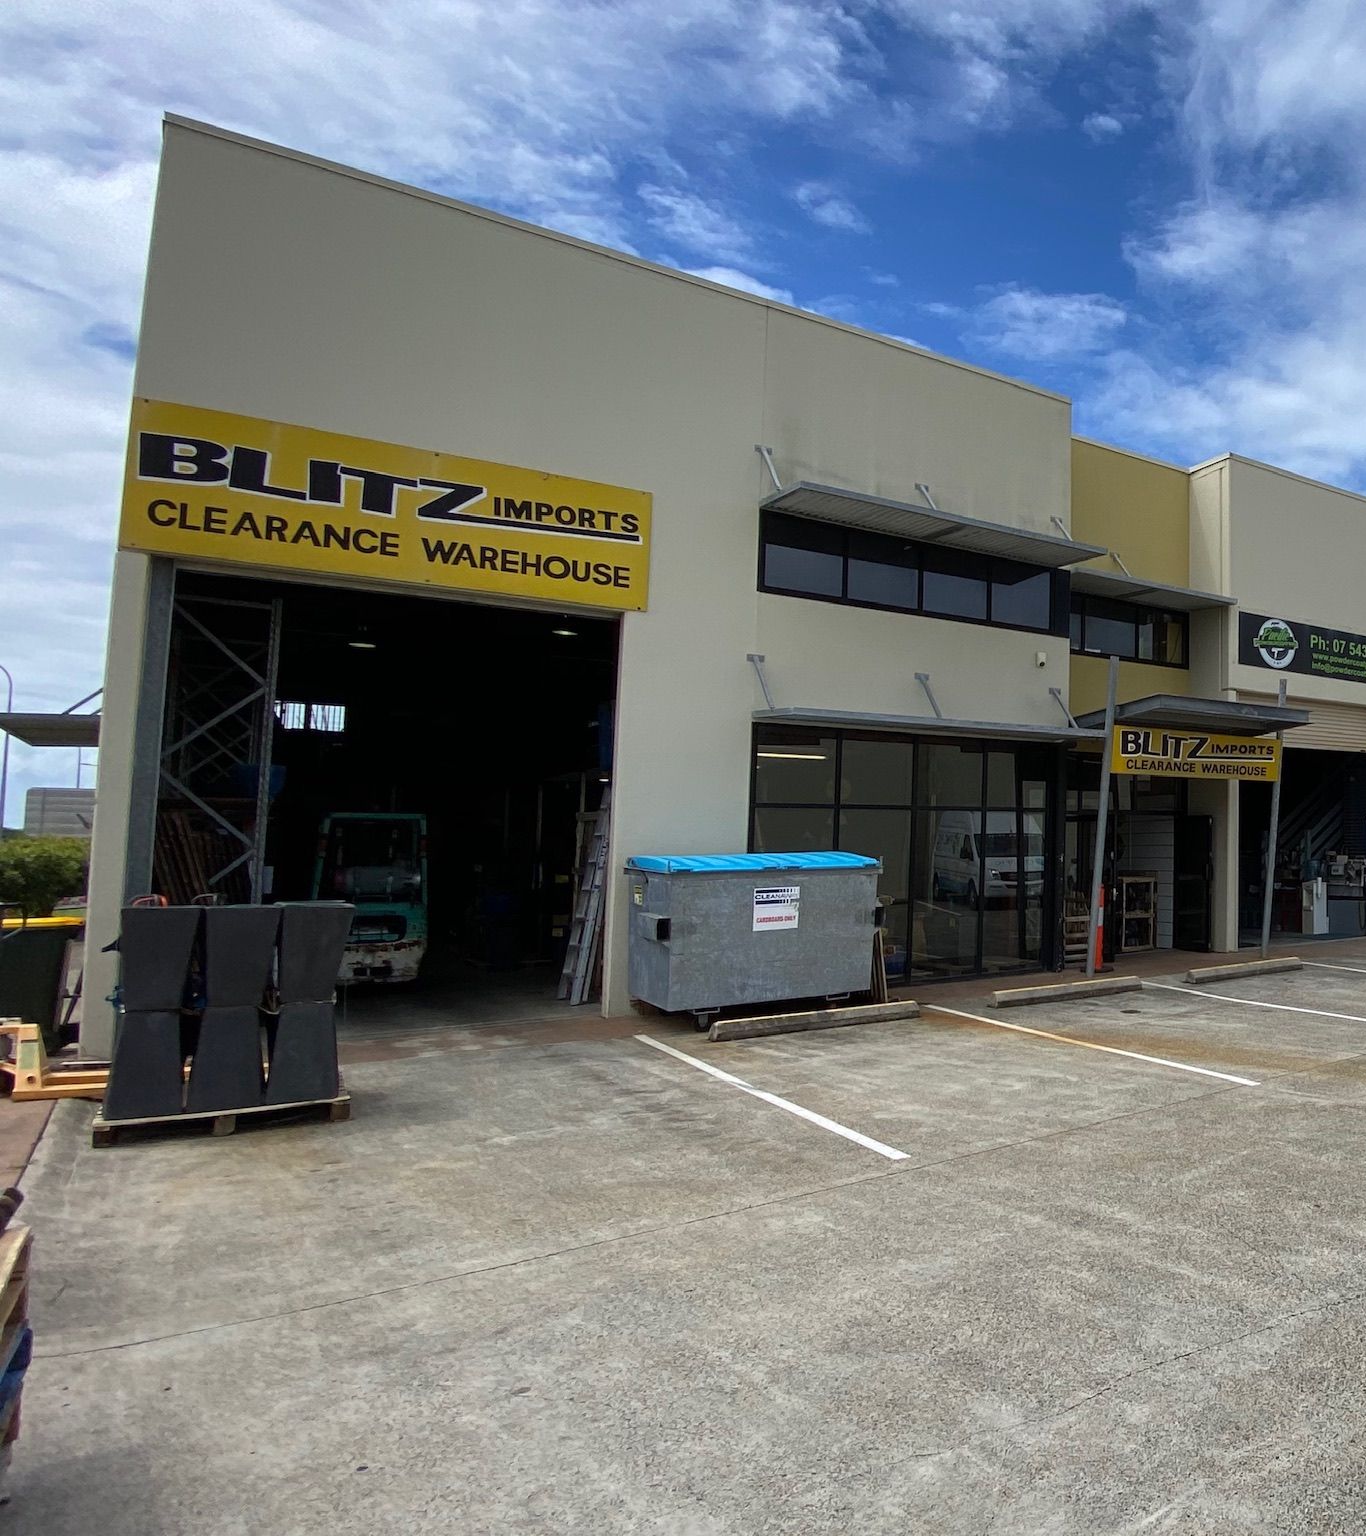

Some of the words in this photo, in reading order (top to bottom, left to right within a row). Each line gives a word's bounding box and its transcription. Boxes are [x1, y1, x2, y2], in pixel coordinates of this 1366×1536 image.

[138, 431, 488, 521] BLITZ
[492, 496, 640, 534] IMPORTS
[147, 499, 400, 558] CLEARANCE
[420, 537, 631, 589] WAREHOUSE
[1310, 634, 1330, 652] Ph:
[1332, 638, 1347, 654] 07
[1120, 729, 1210, 761] BLITZ
[1211, 744, 1275, 755] IMPORTS
[1126, 759, 1196, 773] CLEARANCE
[1201, 763, 1267, 776] WAREHOUSE
